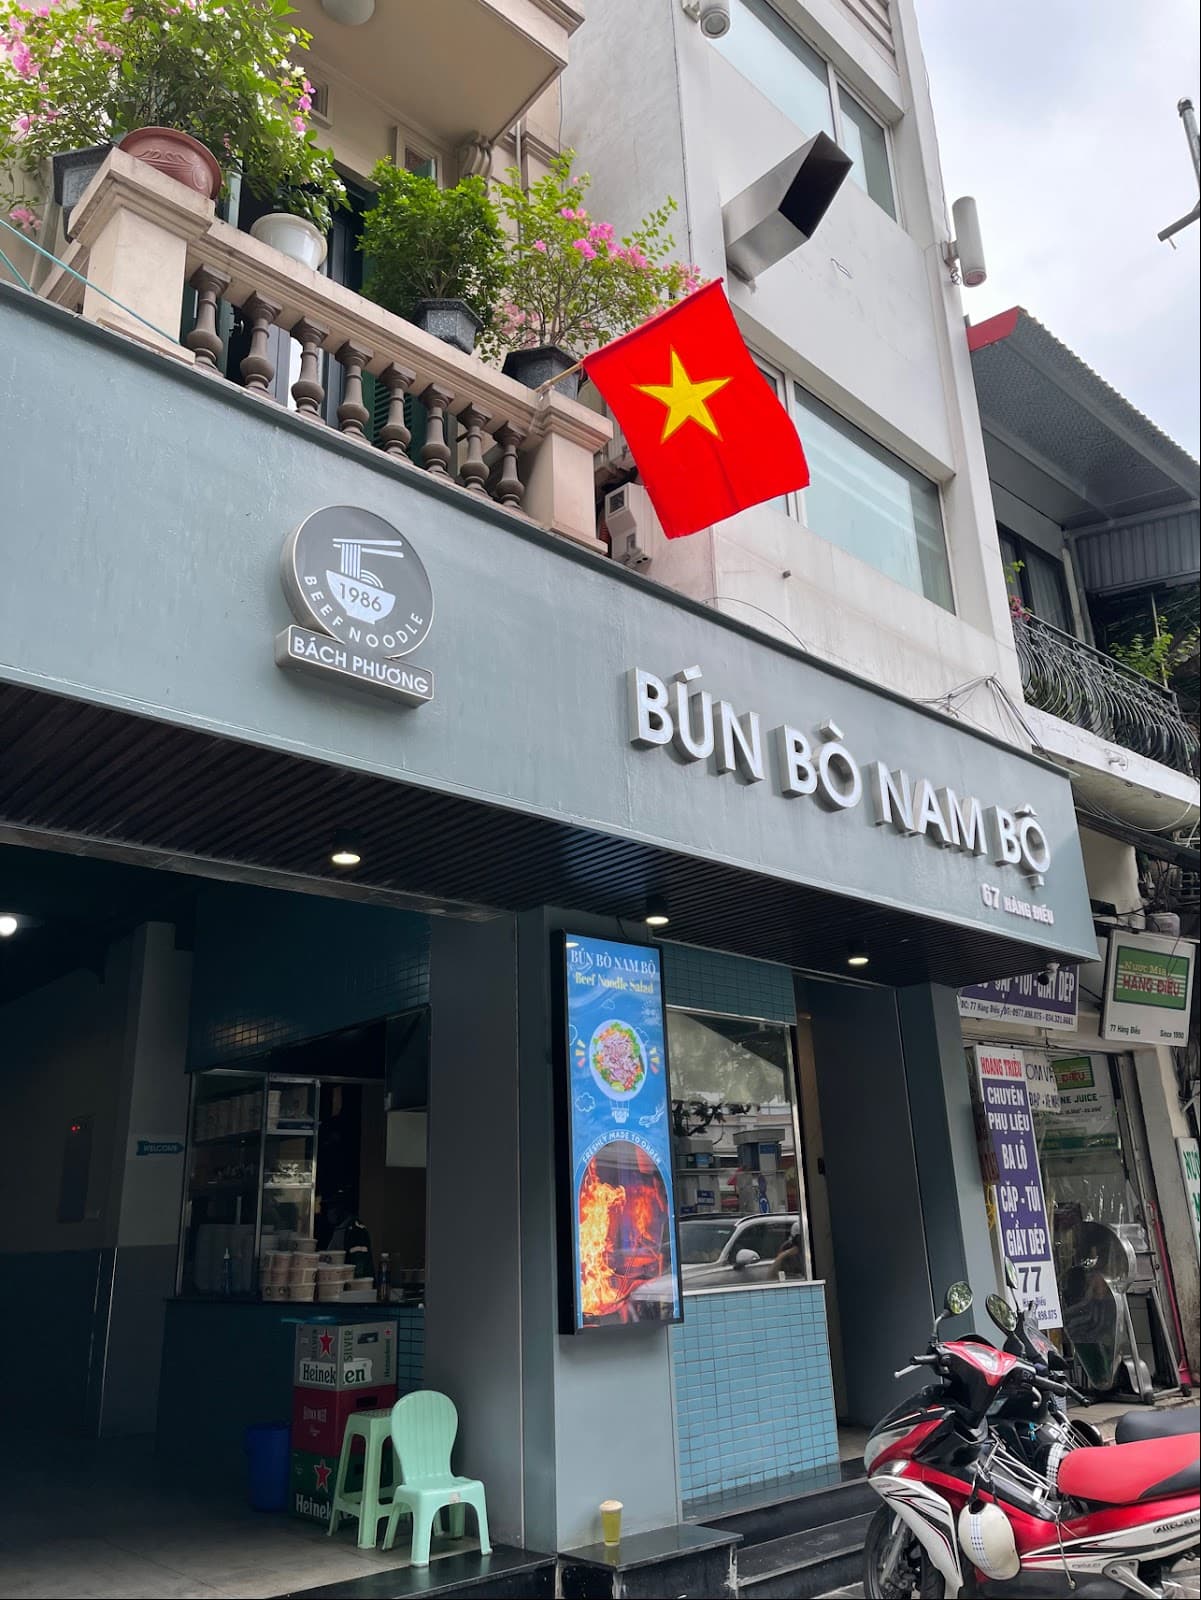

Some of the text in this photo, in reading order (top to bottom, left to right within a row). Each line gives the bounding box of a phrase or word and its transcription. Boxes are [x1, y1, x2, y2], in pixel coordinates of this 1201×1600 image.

[304, 575, 424, 649] BEEF NOODLE
[339, 582, 383, 613] 1986
[293, 637, 430, 694] BÁCH PHƯƠNG
[627, 665, 1051, 888] BÚN BÒ NAM BỘ
[981, 884, 999, 908] 67
[614, 957, 639, 973] NAM
[575, 972, 596, 986] Beef
[598, 974, 629, 991] Noodle
[987, 1085, 1025, 1106] CHUYÊN
[988, 1112, 1008, 1134] PHỤ
[609, 1131, 629, 1140] MADE
[631, 1134, 640, 1144] TO
[640, 1141, 662, 1165] ORDER
[1001, 1139, 1028, 1170] BA LÔ
[1025, 1180, 1042, 1212] TÚI
[1028, 1223, 1046, 1255] DÉP
[1018, 1266, 1042, 1293] 77
